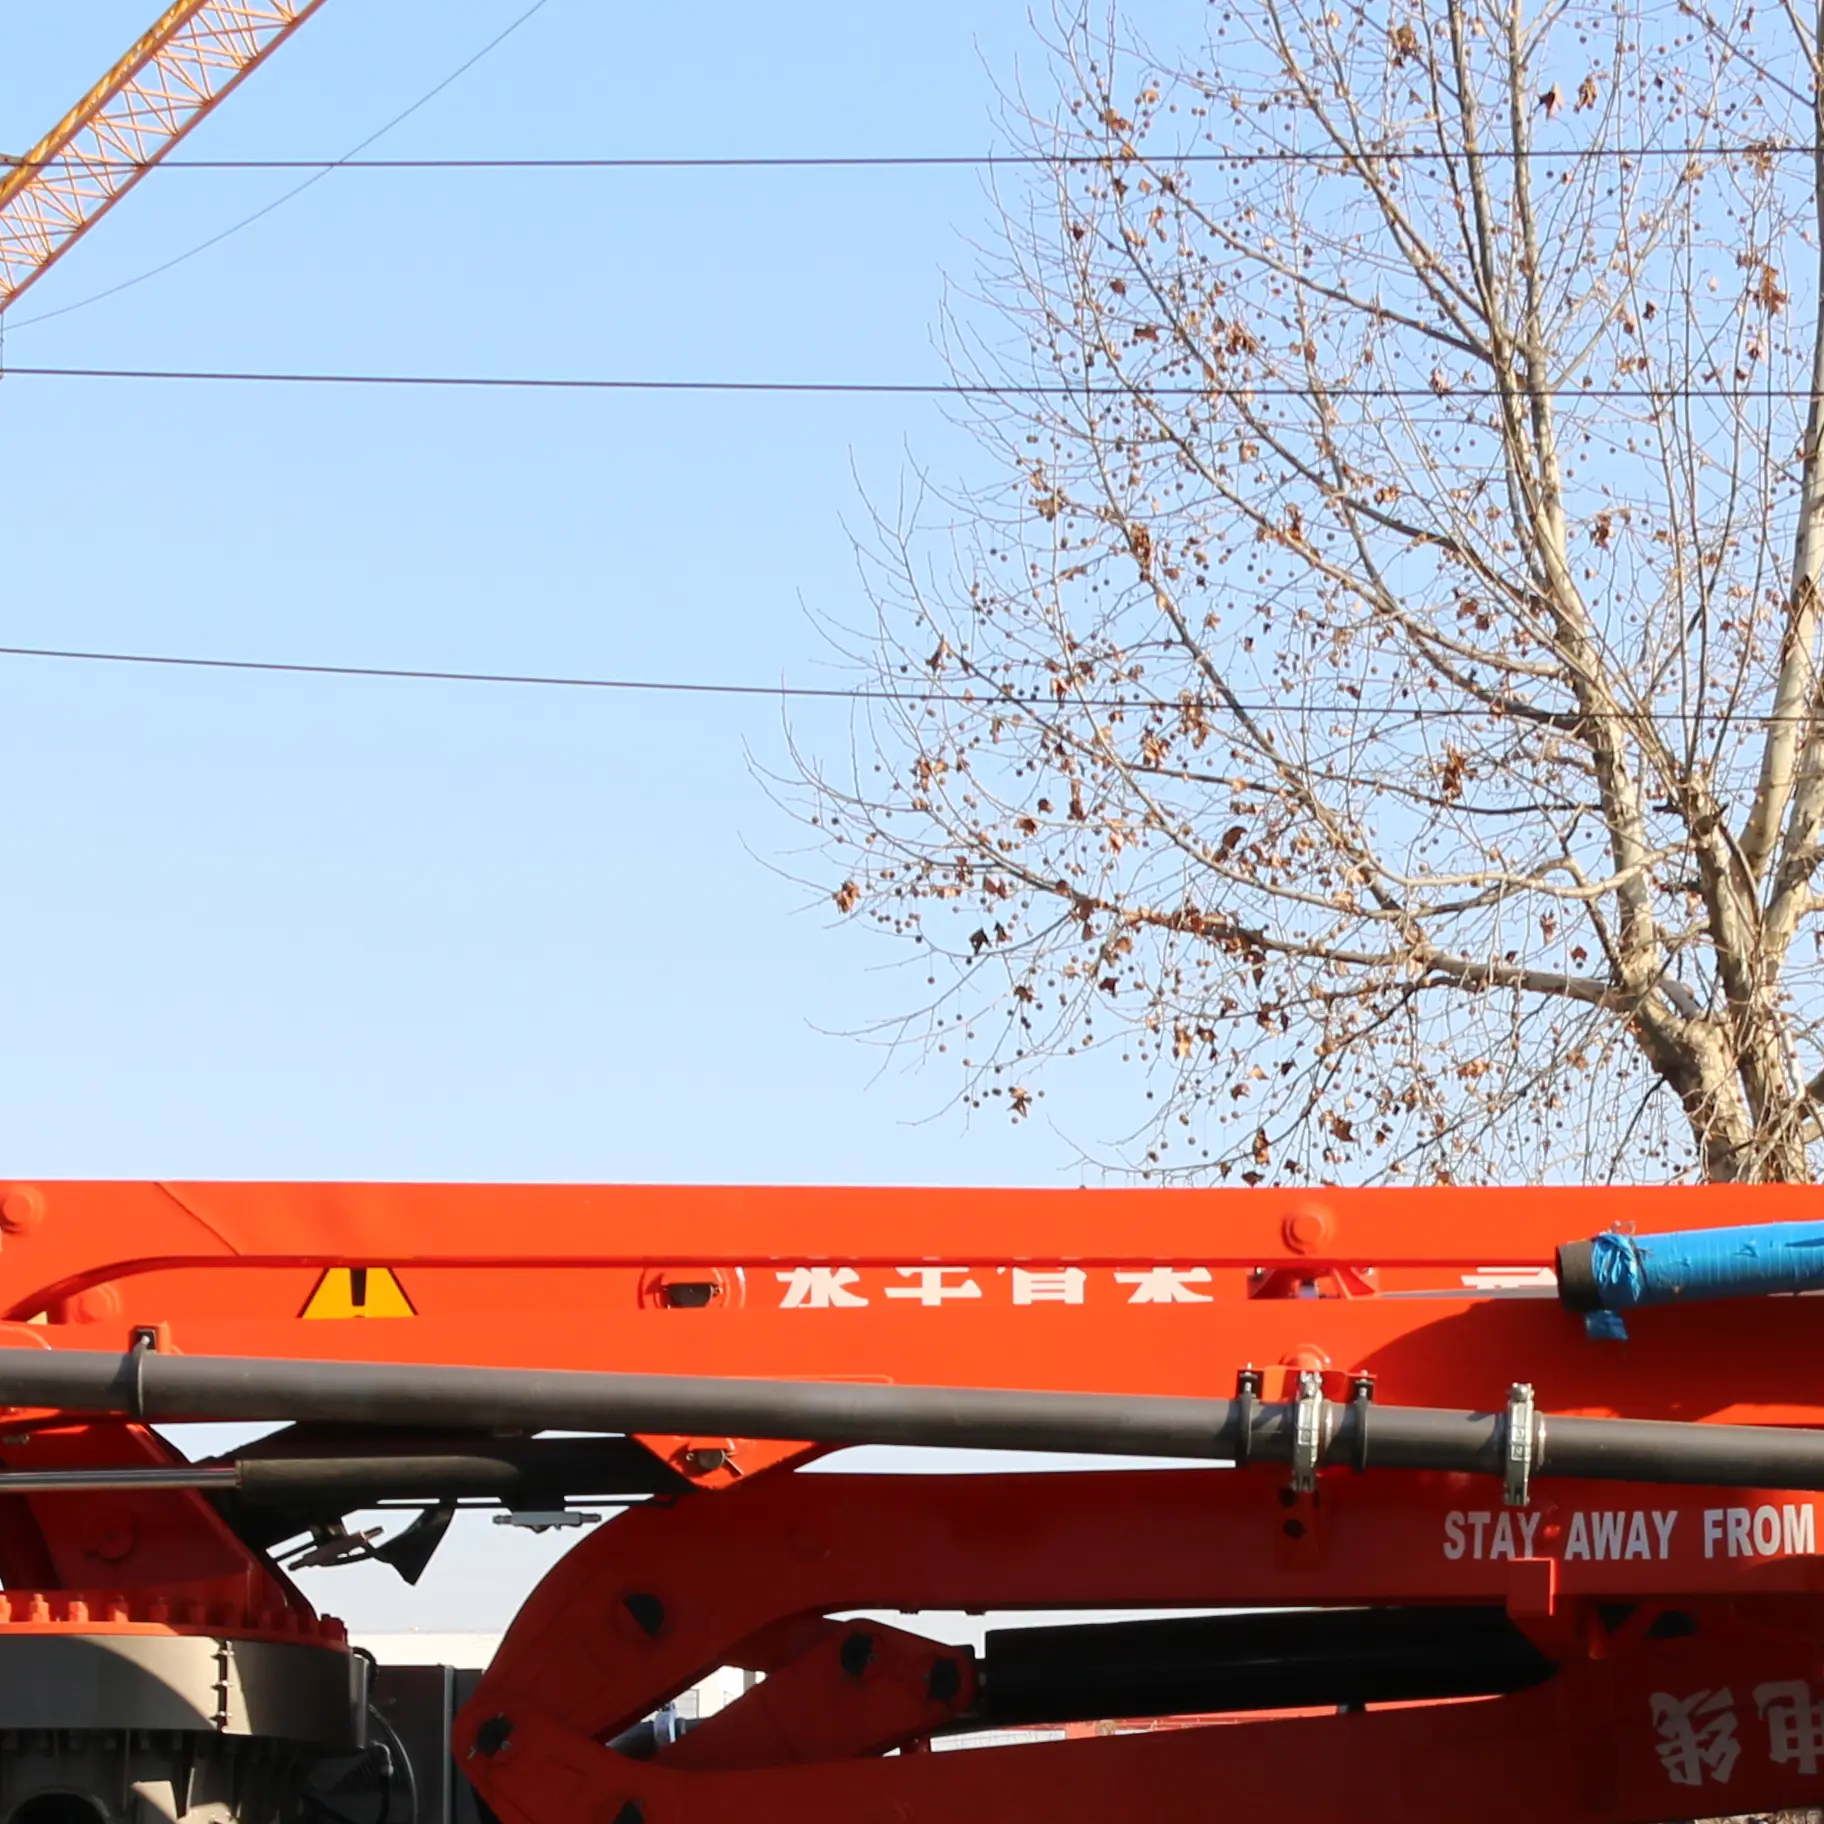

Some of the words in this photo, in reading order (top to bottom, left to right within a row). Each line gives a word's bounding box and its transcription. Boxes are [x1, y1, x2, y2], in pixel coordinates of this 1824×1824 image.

[1442, 1509, 1540, 1560] STAY
[1564, 1509, 1678, 1560] AWAY
[1703, 1503, 1815, 1559] FROM
